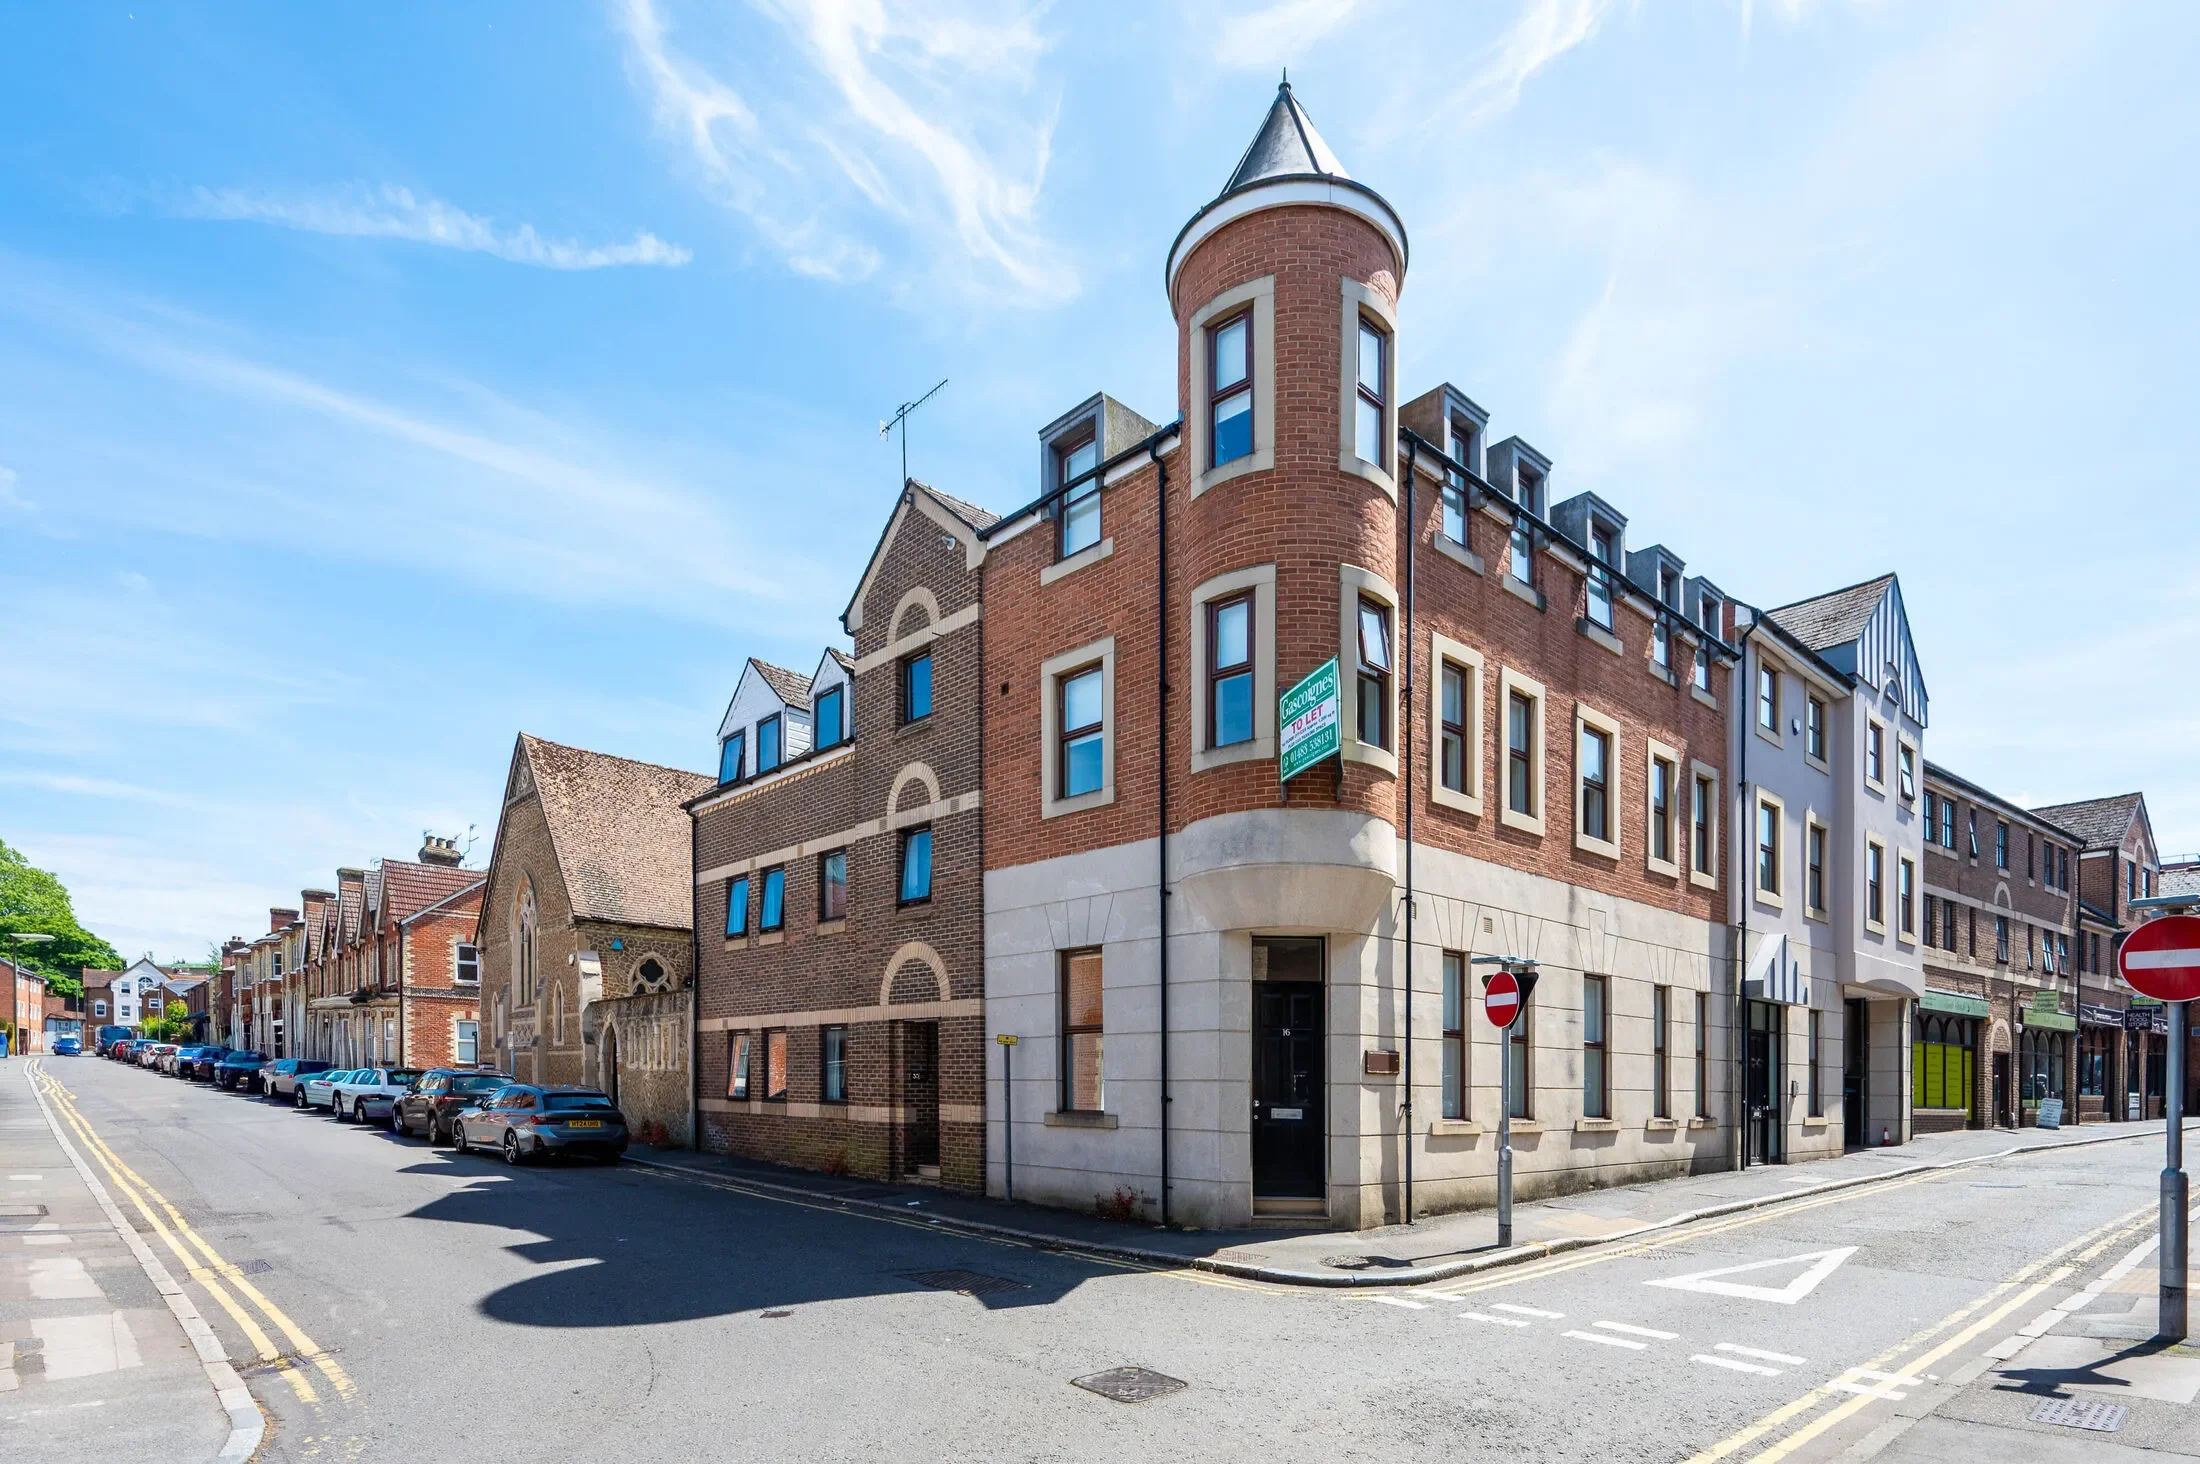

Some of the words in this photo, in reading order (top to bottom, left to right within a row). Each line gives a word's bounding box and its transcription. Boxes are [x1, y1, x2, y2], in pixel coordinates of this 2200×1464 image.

[1282, 672, 1333, 720] Gascoignes
[1291, 717, 1302, 734] TO
[1305, 704, 1323, 725] LET
[1308, 731, 1332, 753] 538131
[1282, 1028, 1291, 1037] 16
